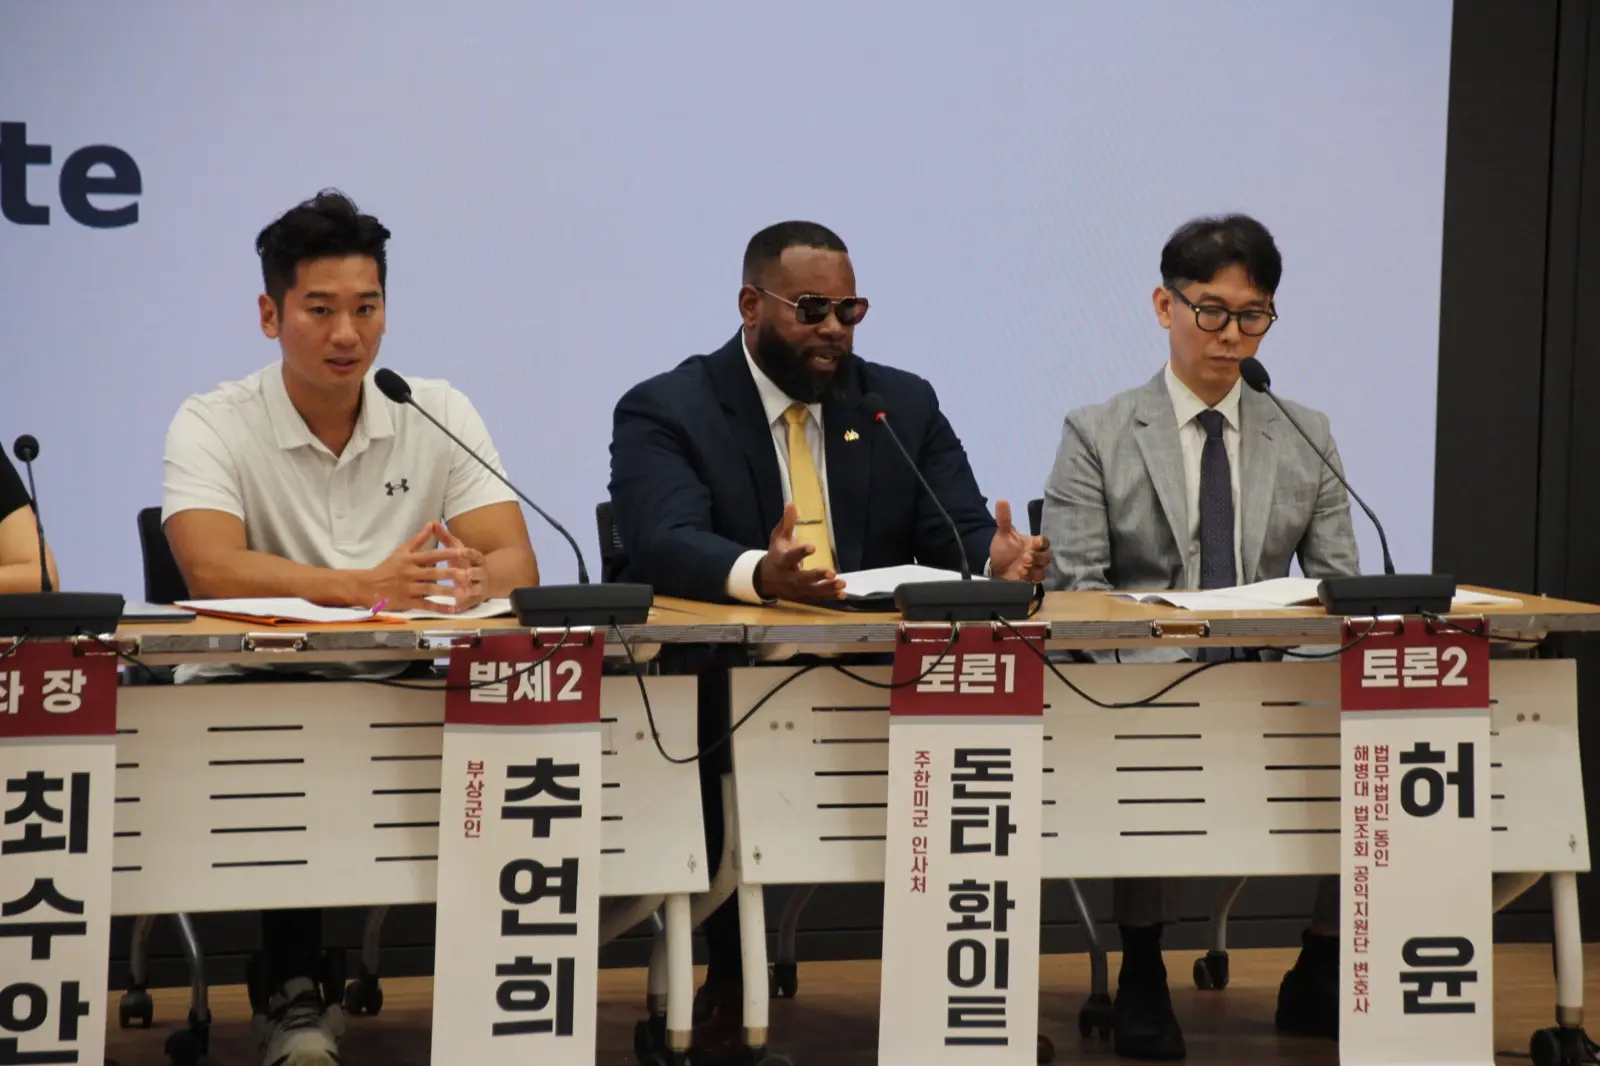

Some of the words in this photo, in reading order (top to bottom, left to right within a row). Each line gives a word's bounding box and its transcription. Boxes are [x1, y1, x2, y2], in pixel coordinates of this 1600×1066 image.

[469, 659, 583, 704] 발제2
[916, 653, 1016, 694] 토론1
[1360, 646, 1468, 689] 토론2
[463, 760, 485, 839] 부상군인
[912, 750, 931, 828] 주한미군
[950, 748, 1017, 857] 돈타
[1353, 745, 1369, 797] 해병대
[1374, 744, 1389, 821] 법무법인
[1399, 741, 1475, 819] 허
[910, 836, 928, 894] 인사처
[1353, 805, 1369, 857] 법조회
[1374, 829, 1389, 868] 동인
[0, 770, 91, 1066] 최수안
[491, 757, 583, 1037] 추연희
[1353, 866, 1370, 953] 공익지원단
[944, 879, 1016, 1047] 화이트
[1353, 961, 1370, 1014] 변호사
[1399, 936, 1478, 1015] 윤
